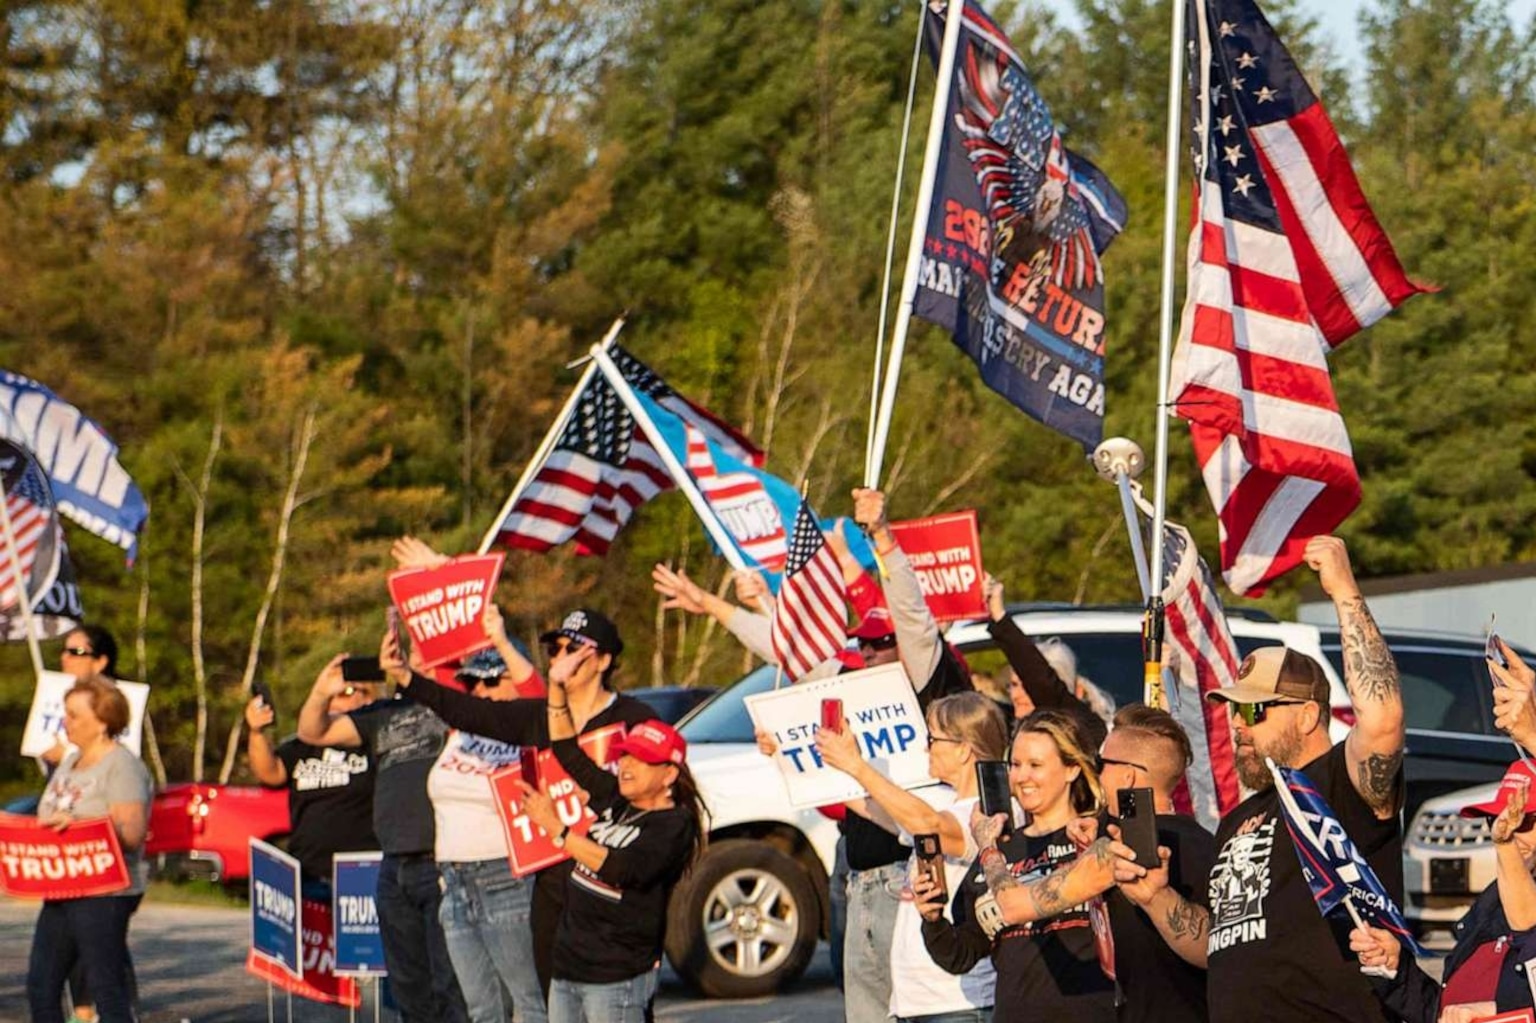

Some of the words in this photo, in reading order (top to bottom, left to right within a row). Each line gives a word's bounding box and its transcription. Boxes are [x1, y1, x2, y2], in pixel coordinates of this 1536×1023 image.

[1002, 261, 1107, 357] RETUR
[936, 545, 971, 564] WITH
[407, 587, 444, 614] STAND
[445, 578, 485, 599] WITH
[914, 564, 976, 597] RUMP
[408, 594, 483, 643] TRUMP
[855, 702, 907, 724] WITH
[7, 841, 61, 858] STAND
[64, 837, 109, 856] WITH
[3, 851, 116, 881] TRUMP
[255, 879, 296, 924] TRUMP
